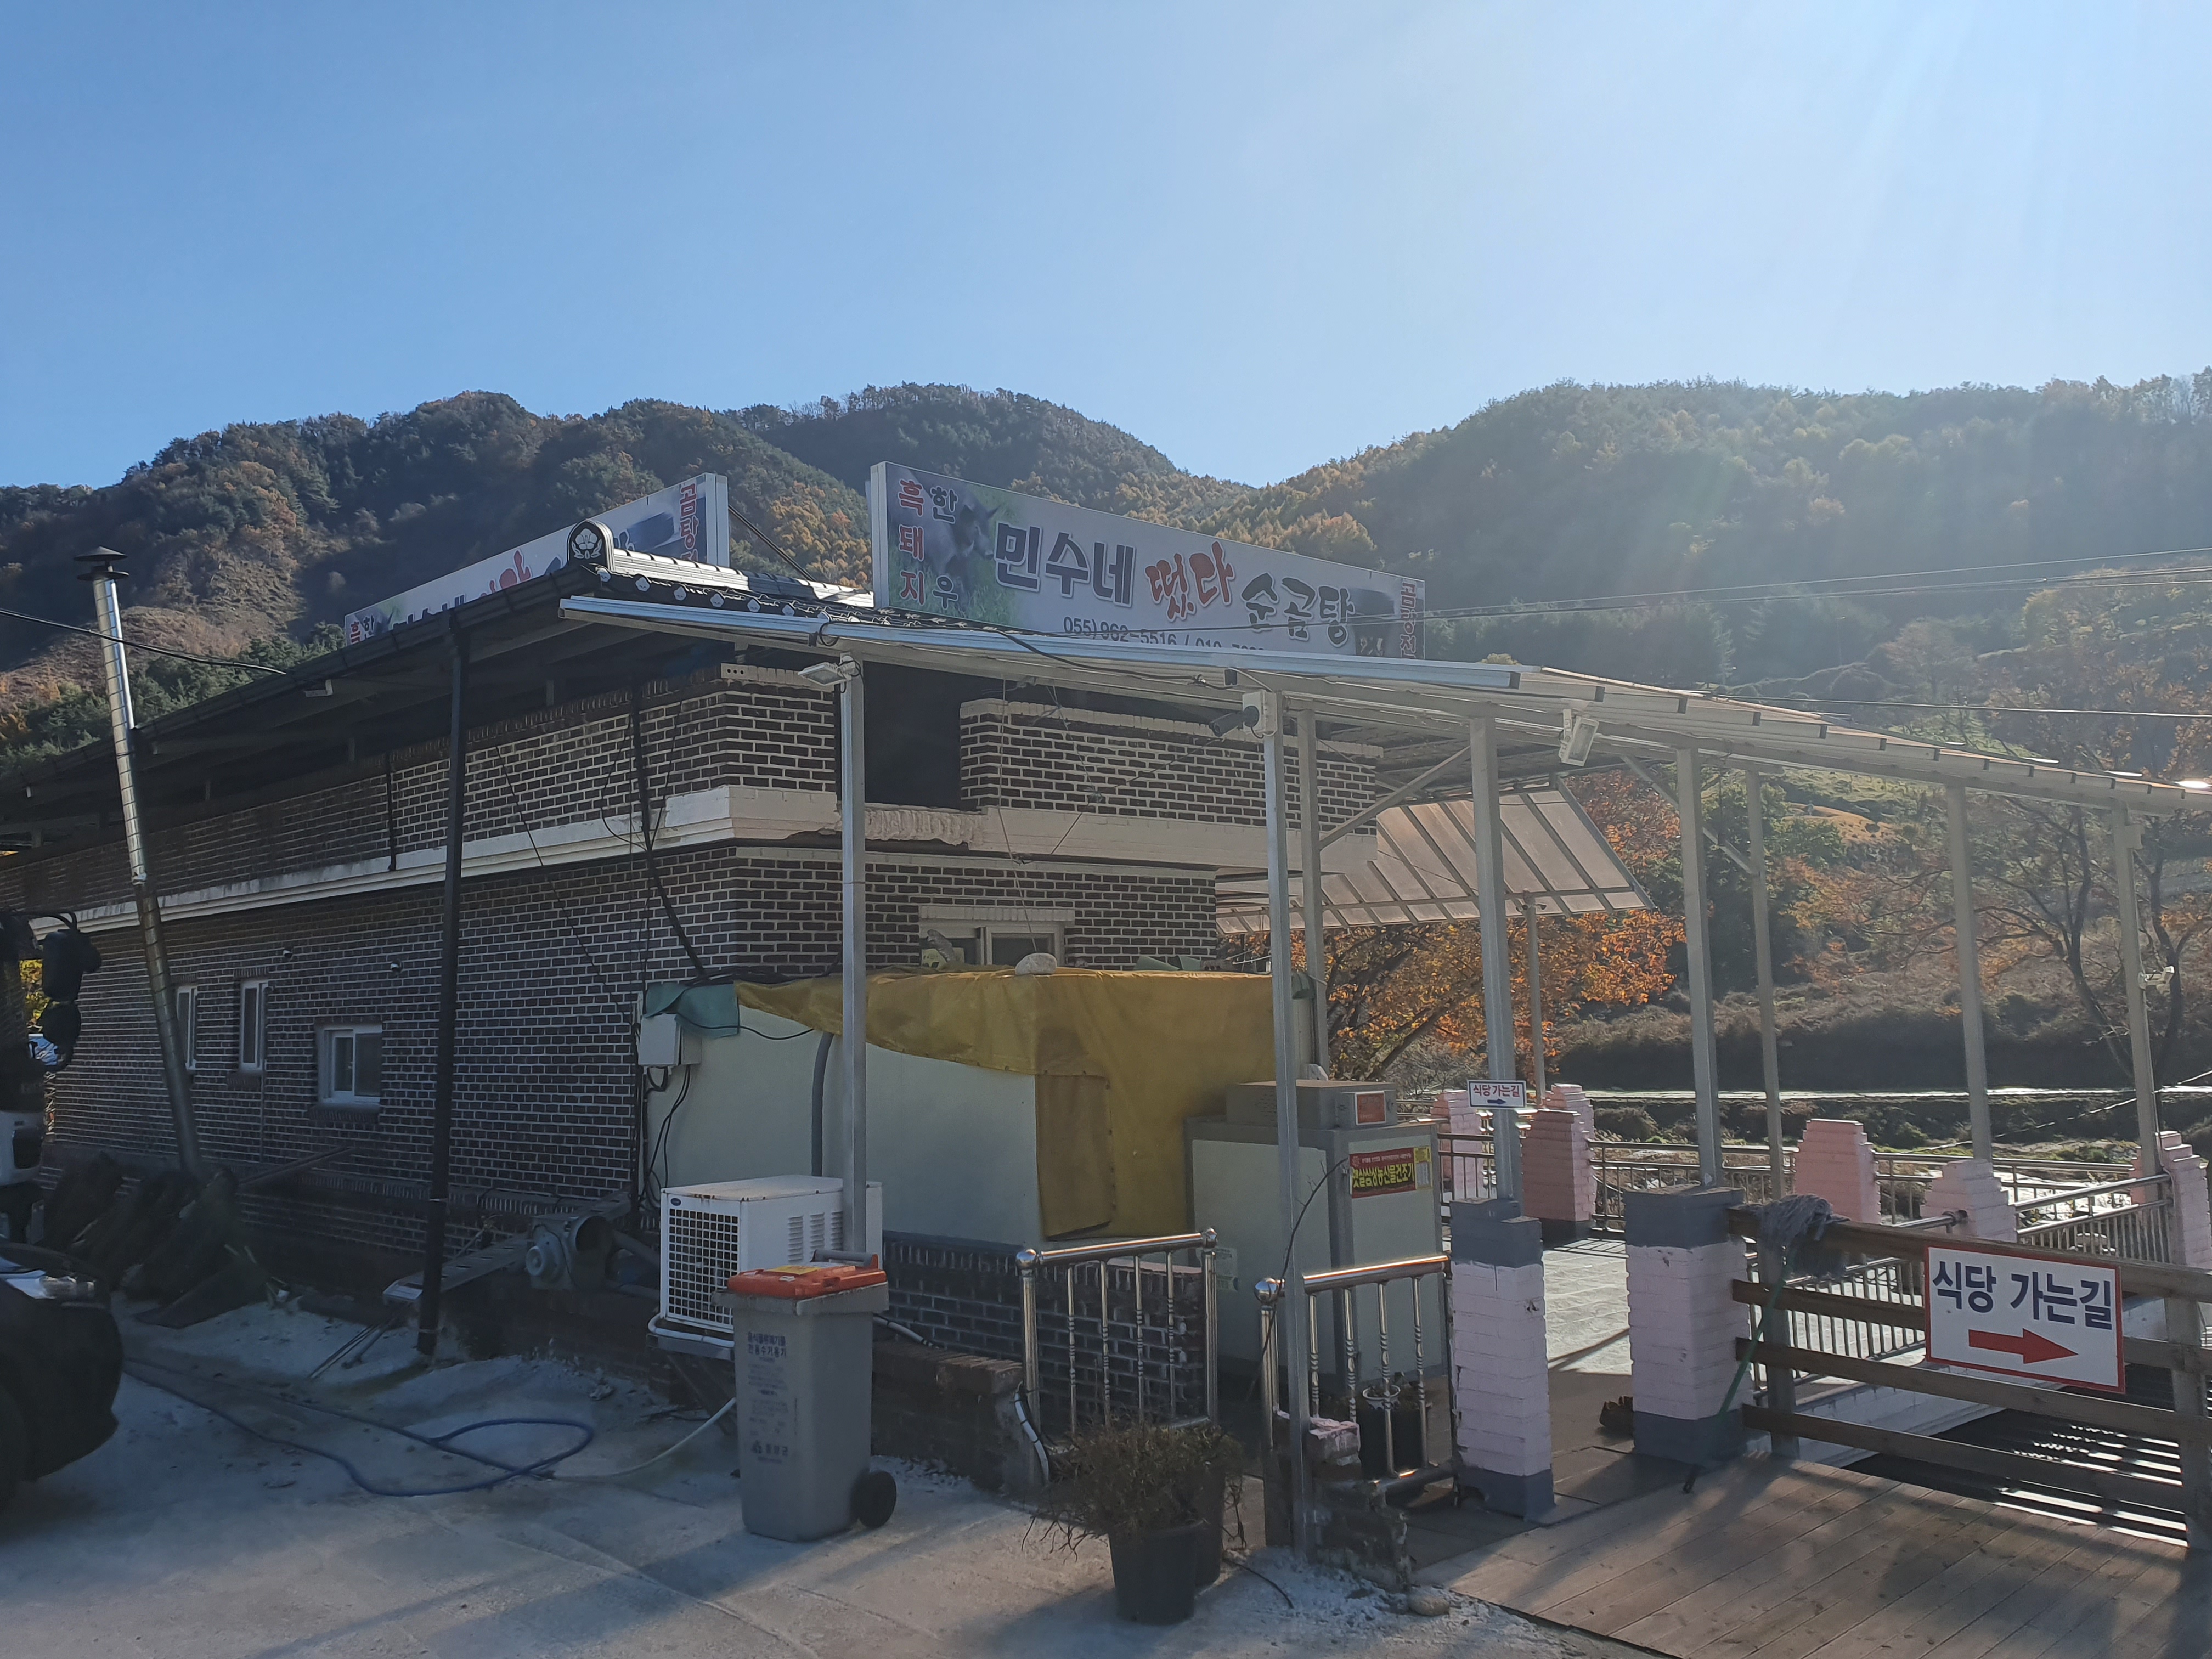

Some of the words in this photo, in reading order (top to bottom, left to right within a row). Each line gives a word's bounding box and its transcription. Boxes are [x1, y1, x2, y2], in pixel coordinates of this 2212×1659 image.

[899, 479, 924, 605] 흑돼지
[995, 522, 1135, 606] 민수네
[1240, 572, 1354, 645] 순곰탕
[1932, 1261, 1997, 1313] 식당
[2010, 1271, 2112, 1330] 가는길
